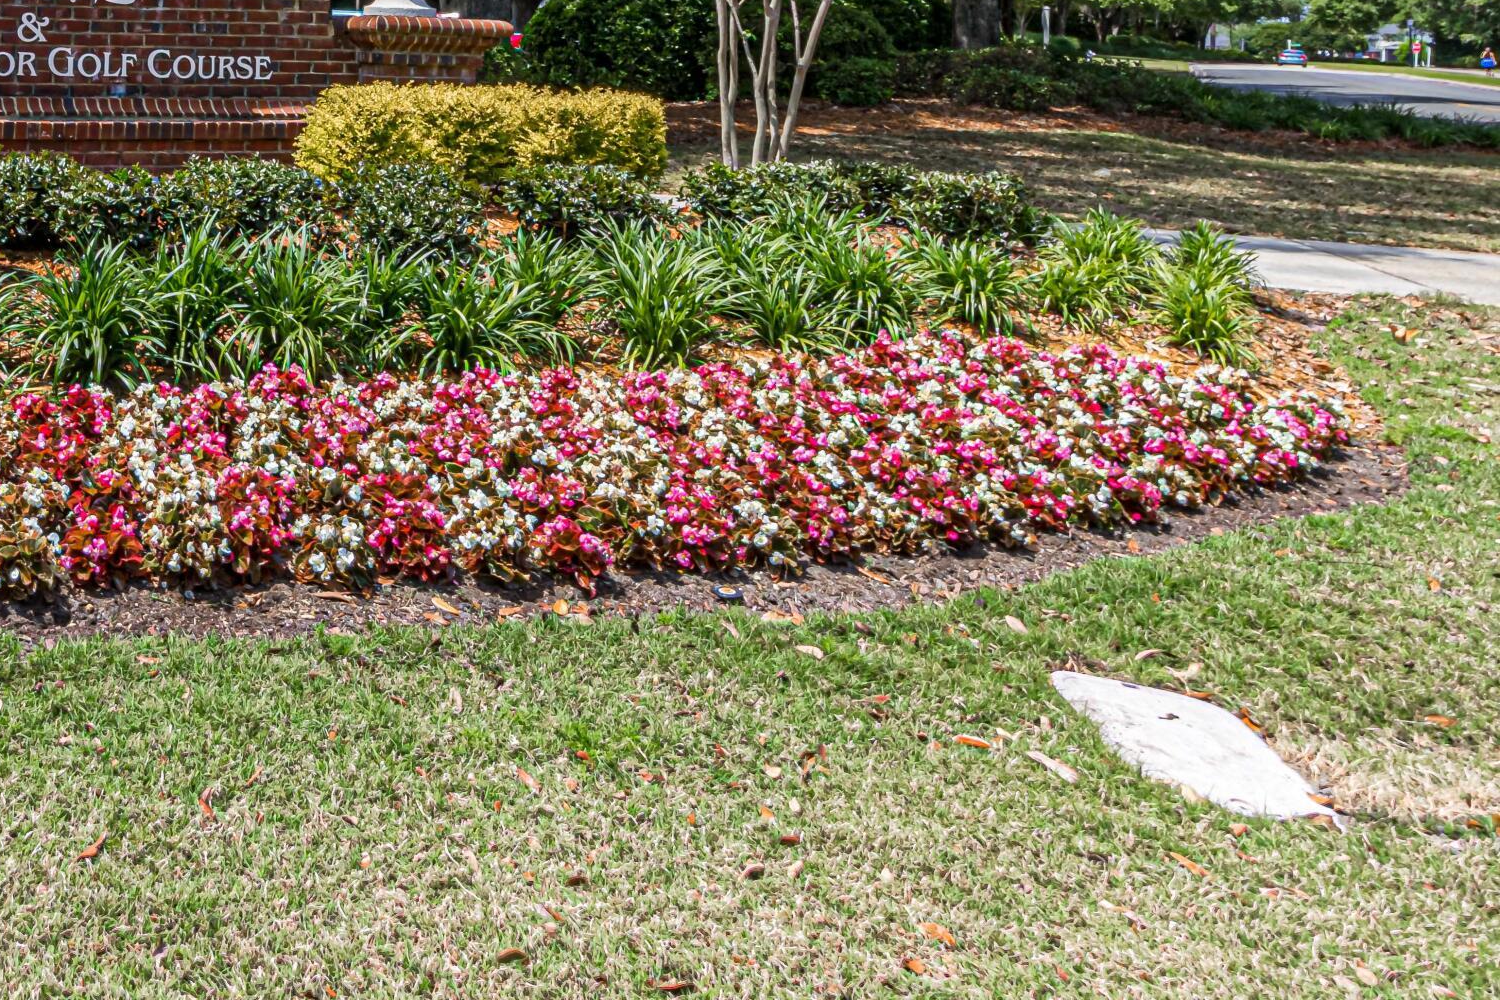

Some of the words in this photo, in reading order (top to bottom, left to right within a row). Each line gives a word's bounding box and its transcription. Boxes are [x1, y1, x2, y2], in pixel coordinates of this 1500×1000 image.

[17, 12, 49, 43] &
[48, 47, 138, 77] GOLF
[147, 49, 274, 80] COURSE
